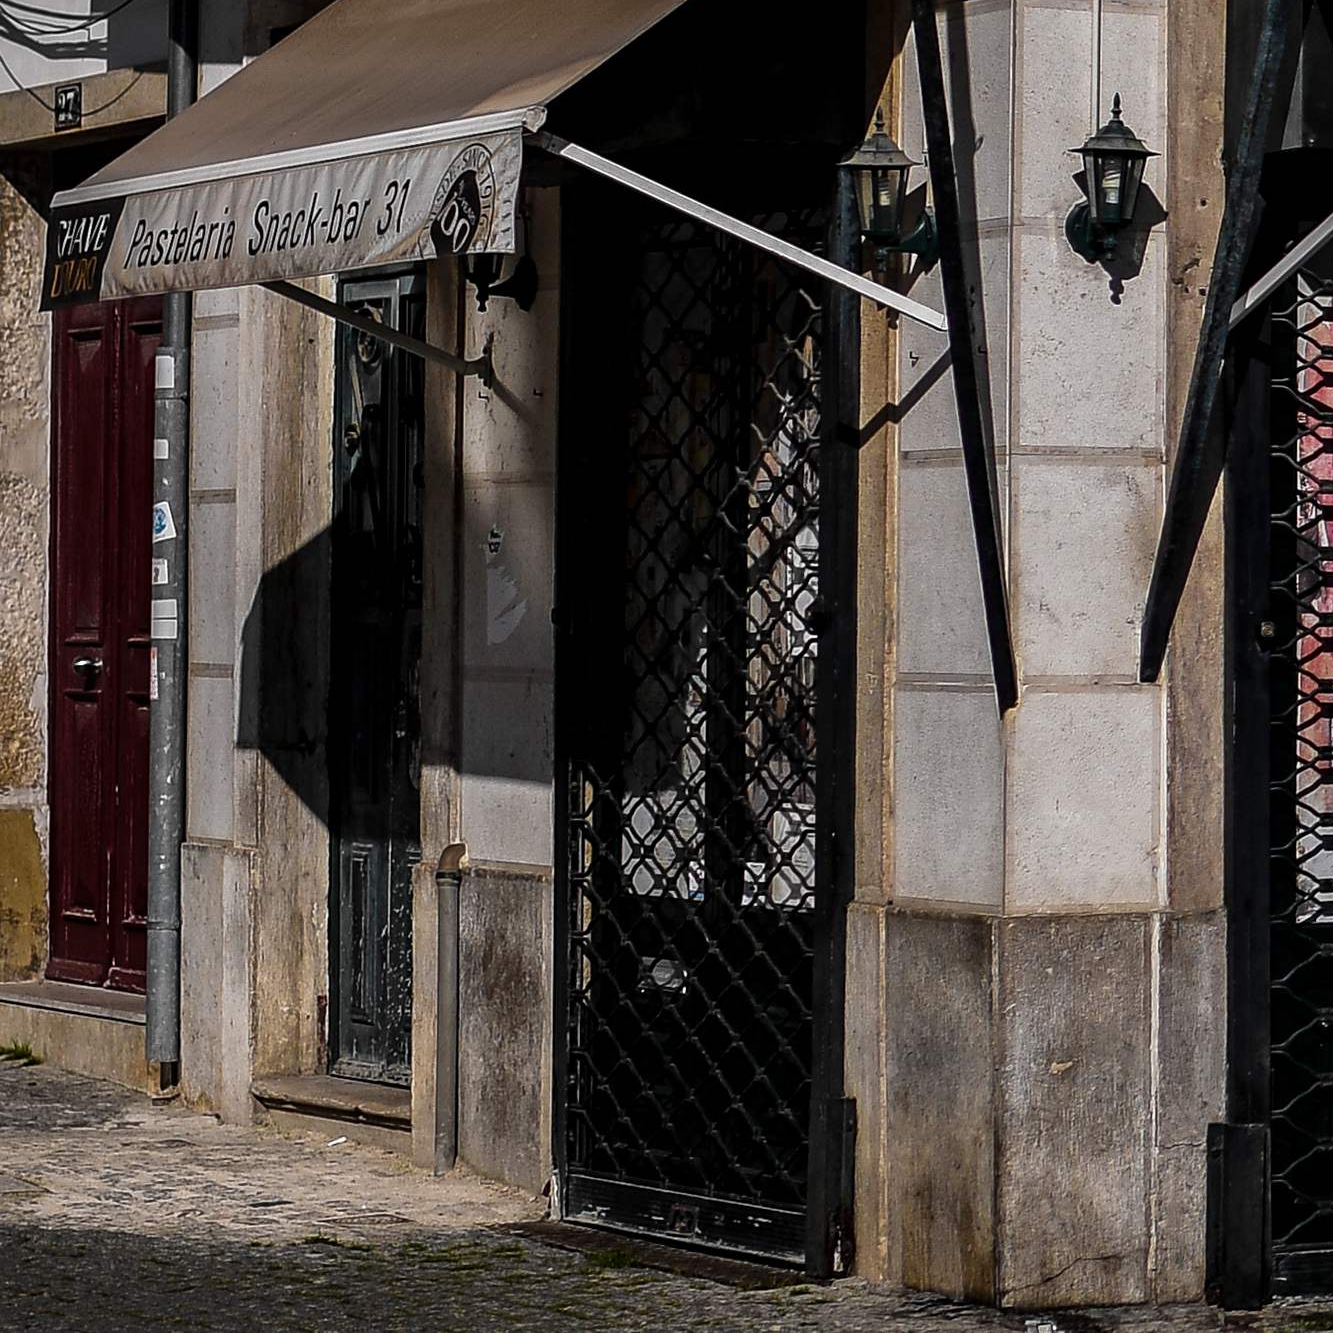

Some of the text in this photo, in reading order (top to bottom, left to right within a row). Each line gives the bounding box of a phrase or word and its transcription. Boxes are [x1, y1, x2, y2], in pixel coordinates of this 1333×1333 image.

[123, 177, 411, 270] Pastelaria Snack-bar 31
